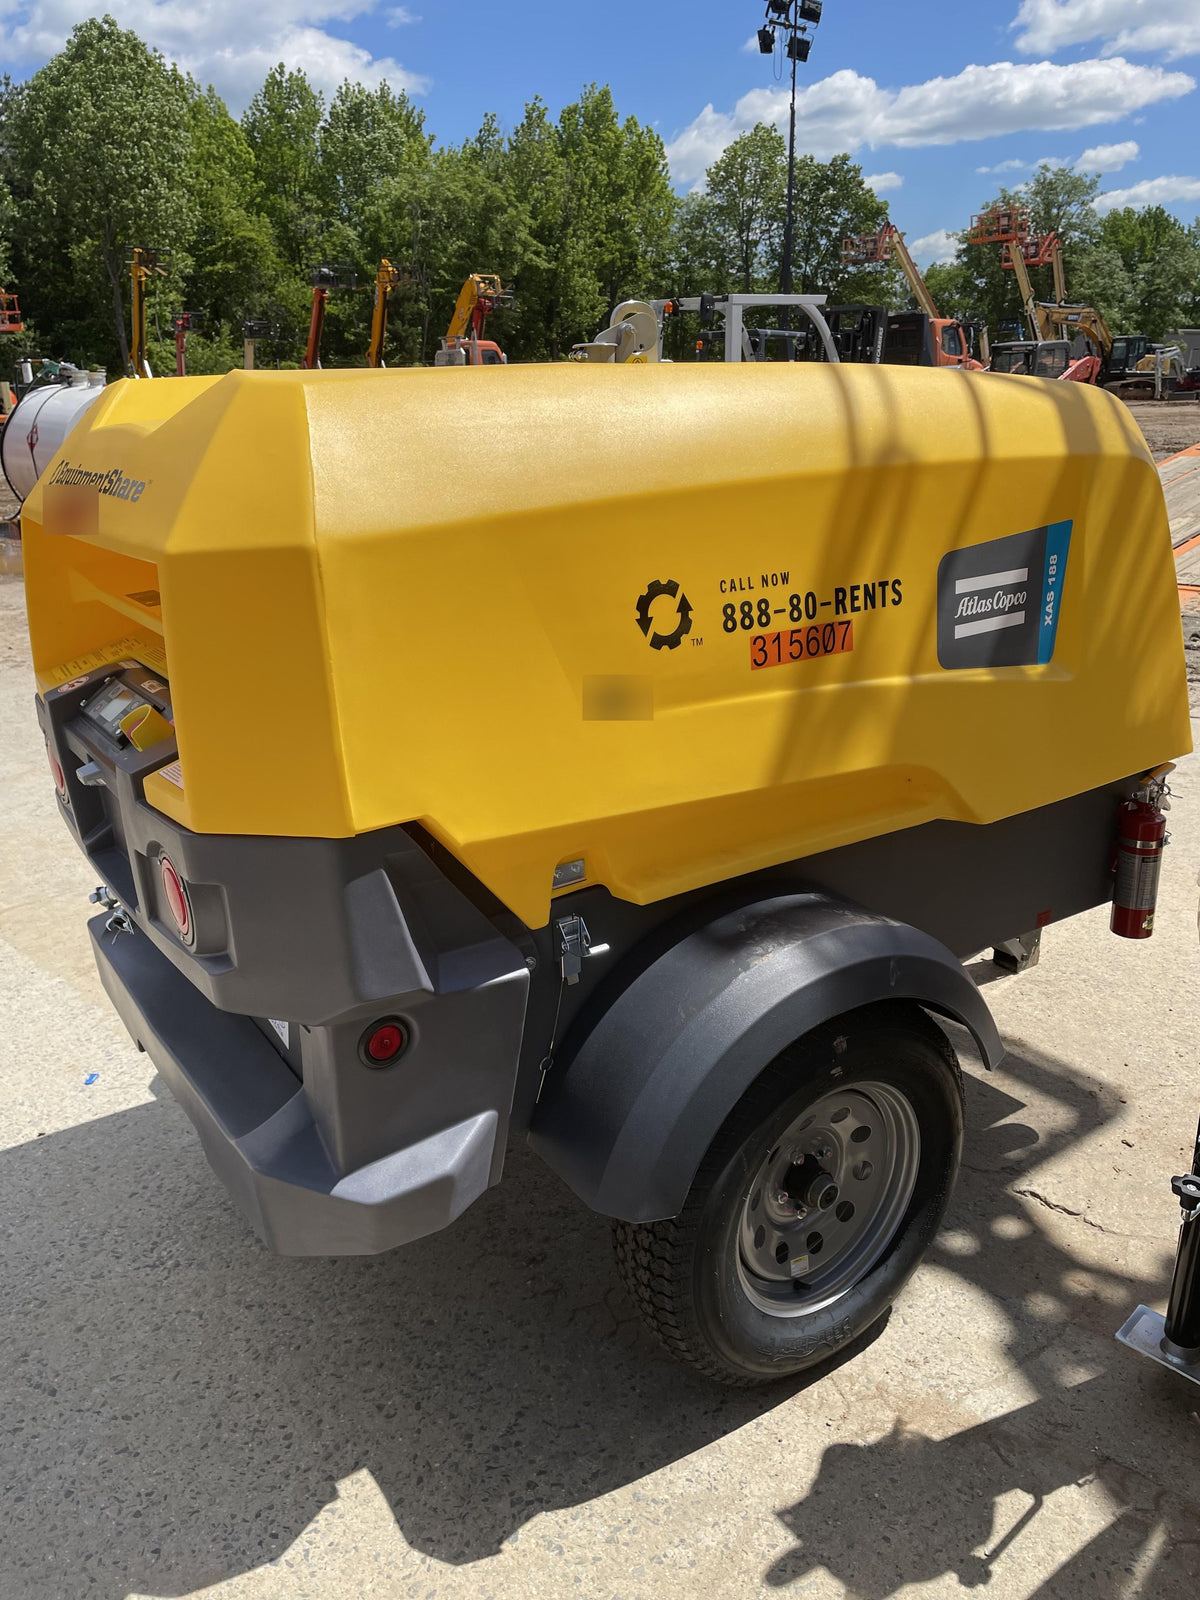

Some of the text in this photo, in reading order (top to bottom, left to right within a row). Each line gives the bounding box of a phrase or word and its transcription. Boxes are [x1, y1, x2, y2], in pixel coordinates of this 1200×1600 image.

[719, 571, 790, 593] CALL NOW
[722, 578, 903, 633] 888-80-RENTS
[1044, 554, 1058, 626] XAS 188
[691, 637, 704, 647] TM
[752, 620, 852, 667] 315607
